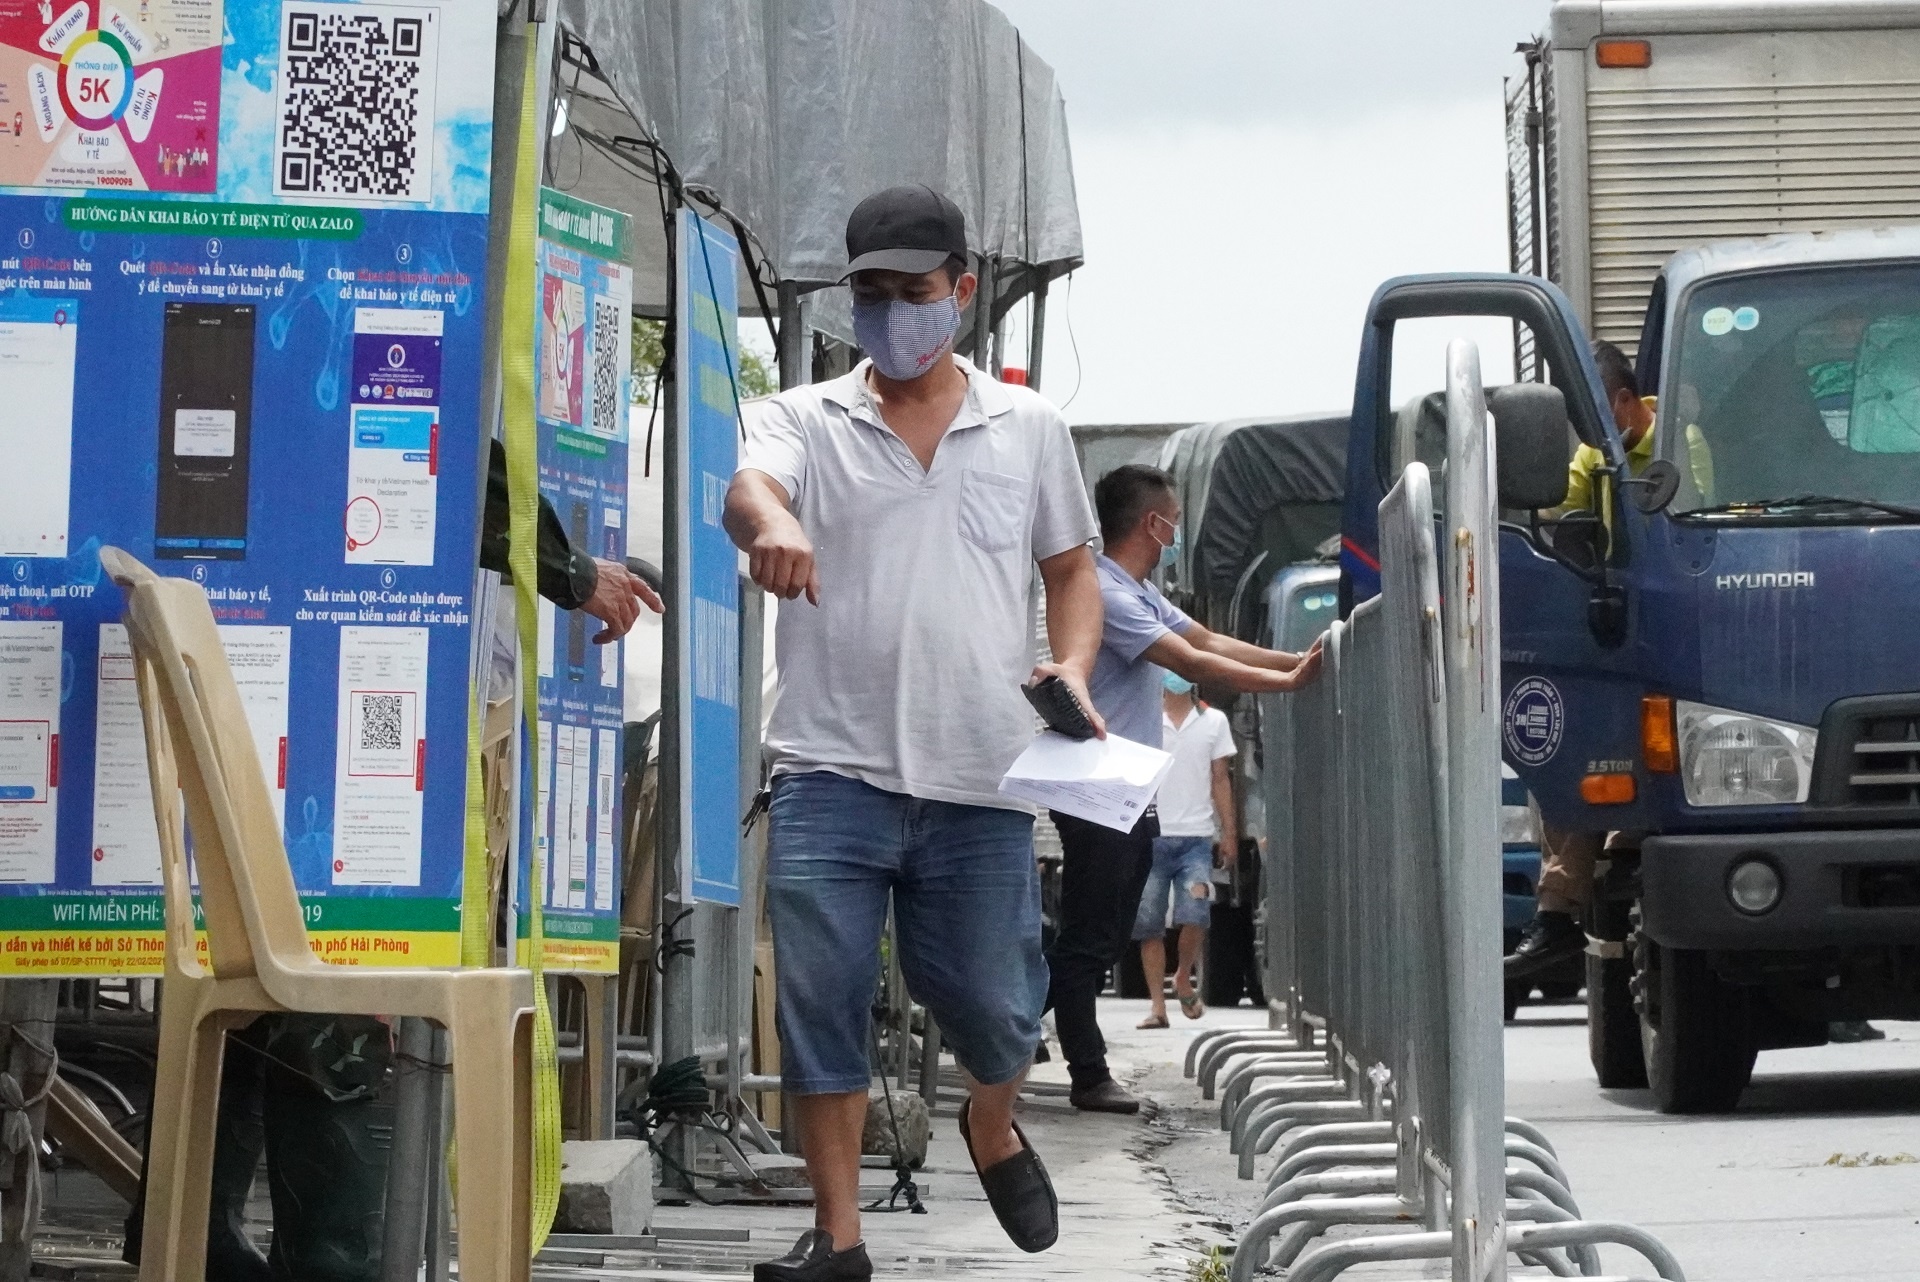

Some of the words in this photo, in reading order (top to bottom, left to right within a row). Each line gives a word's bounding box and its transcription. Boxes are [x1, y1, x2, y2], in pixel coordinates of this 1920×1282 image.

[64, 9, 84, 31] TRANG
[75, 61, 100, 71] THÔNG
[79, 78, 111, 103] 5K
[78, 133, 95, 146] KHAI
[86, 150, 91, 159] Y
[71, 206, 117, 222] HƯỚNG
[119, 207, 145, 223] DẪN
[149, 211, 179, 224] KHAI
[183, 210, 208, 225] BÁO
[211, 213, 220, 225] Y
[221, 211, 237, 226] TẾ
[240, 213, 269, 230] ĐIỆN
[272, 212, 290, 228] TỬ
[291, 216, 318, 231] QUA
[320, 216, 354, 231] ZALO
[2, 257, 19, 269] nút
[73, 258, 92, 271] bên
[120, 260, 145, 275] Quét
[199, 262, 211, 275] và
[213, 260, 226, 276] ấn
[228, 263, 248, 277] Xác
[251, 265, 277, 280] nhận
[279, 262, 304, 281] đồng
[19, 276, 40, 289] trên
[43, 277, 66, 290] màn
[68, 277, 92, 291] hình
[327, 267, 355, 283] Chọn
[138, 279, 145, 294] ý
[147, 277, 160, 293] để
[162, 278, 199, 297] chuyển
[201, 284, 225, 298] sang
[227, 282, 239, 295] tờ
[240, 282, 263, 295] khai
[264, 286, 271, 299] y
[273, 281, 284, 297] tế
[339, 286, 352, 299] để
[355, 287, 376, 300] khai
[379, 288, 397, 301] báo
[400, 292, 406, 305] y
[408, 283, 418, 301] tế
[420, 288, 442, 305] điện
[444, 288, 456, 303] tử
[1716, 572, 1814, 590] HYUNDAI
[0, 584, 16, 600] iện
[20, 585, 48, 600] thoại,
[51, 585, 66, 597] mã
[69, 585, 95, 598] OTP
[229, 588, 248, 601] báo
[250, 591, 257, 603] y
[259, 585, 271, 603] tế,
[303, 586, 328, 603] Xuất
[331, 590, 357, 603] trình
[359, 590, 407, 605] QR-Code
[409, 592, 434, 607] nhận
[437, 592, 463, 608] được
[296, 608, 314, 621] cho
[316, 610, 329, 621] cơ
[331, 611, 356, 624] quan
[359, 606, 384, 622] kiểm
[386, 609, 406, 622] soát
[409, 606, 421, 622] để
[424, 610, 441, 623] xác
[444, 611, 469, 627] nhận
[53, 904, 85, 921] WIFI
[89, 899, 127, 921] MIỄN
[131, 901, 159, 921] PHÍ:
[6, 936, 27, 952] dẫn
[31, 938, 45, 952] và
[49, 936, 75, 952] thiết
[79, 936, 92, 952] kế
[96, 936, 113, 951] bởi
[117, 936, 132, 951] Sở
[136, 937, 164, 952] Thôn
[326, 936, 347, 954] phố
[351, 937, 370, 952] Hải
[374, 938, 409, 954] Phòng
[108, 957, 124, 967] ngày
